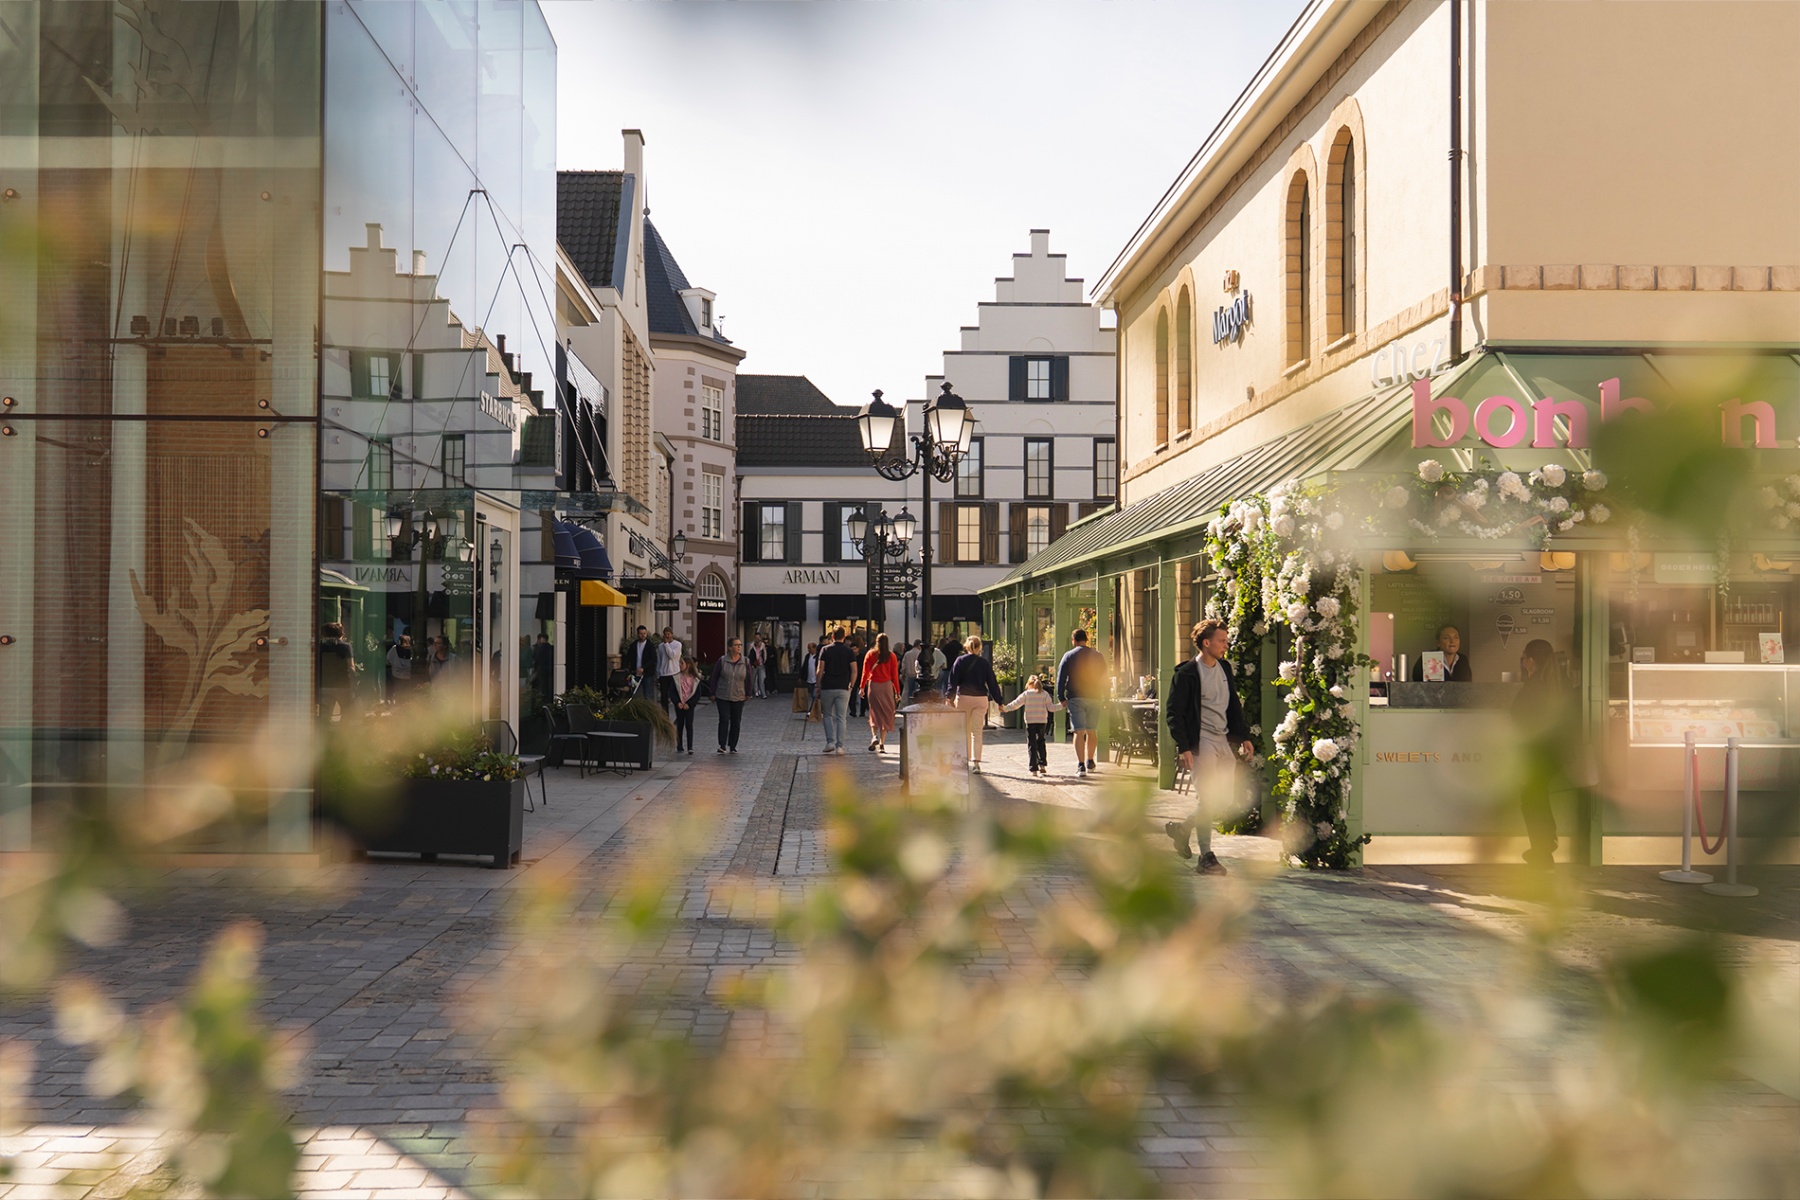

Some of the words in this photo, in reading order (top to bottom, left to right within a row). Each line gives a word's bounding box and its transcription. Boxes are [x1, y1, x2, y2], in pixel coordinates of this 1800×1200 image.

[1213, 290, 1249, 345] Margot
[1371, 338, 1446, 388] chez
[1411, 377, 1779, 448] bonbn
[782, 569, 841, 585] ARMANI
[1501, 591, 1521, 599] 1.50
[1376, 752, 1441, 763] SWEETS
[1451, 752, 1482, 763] AND
